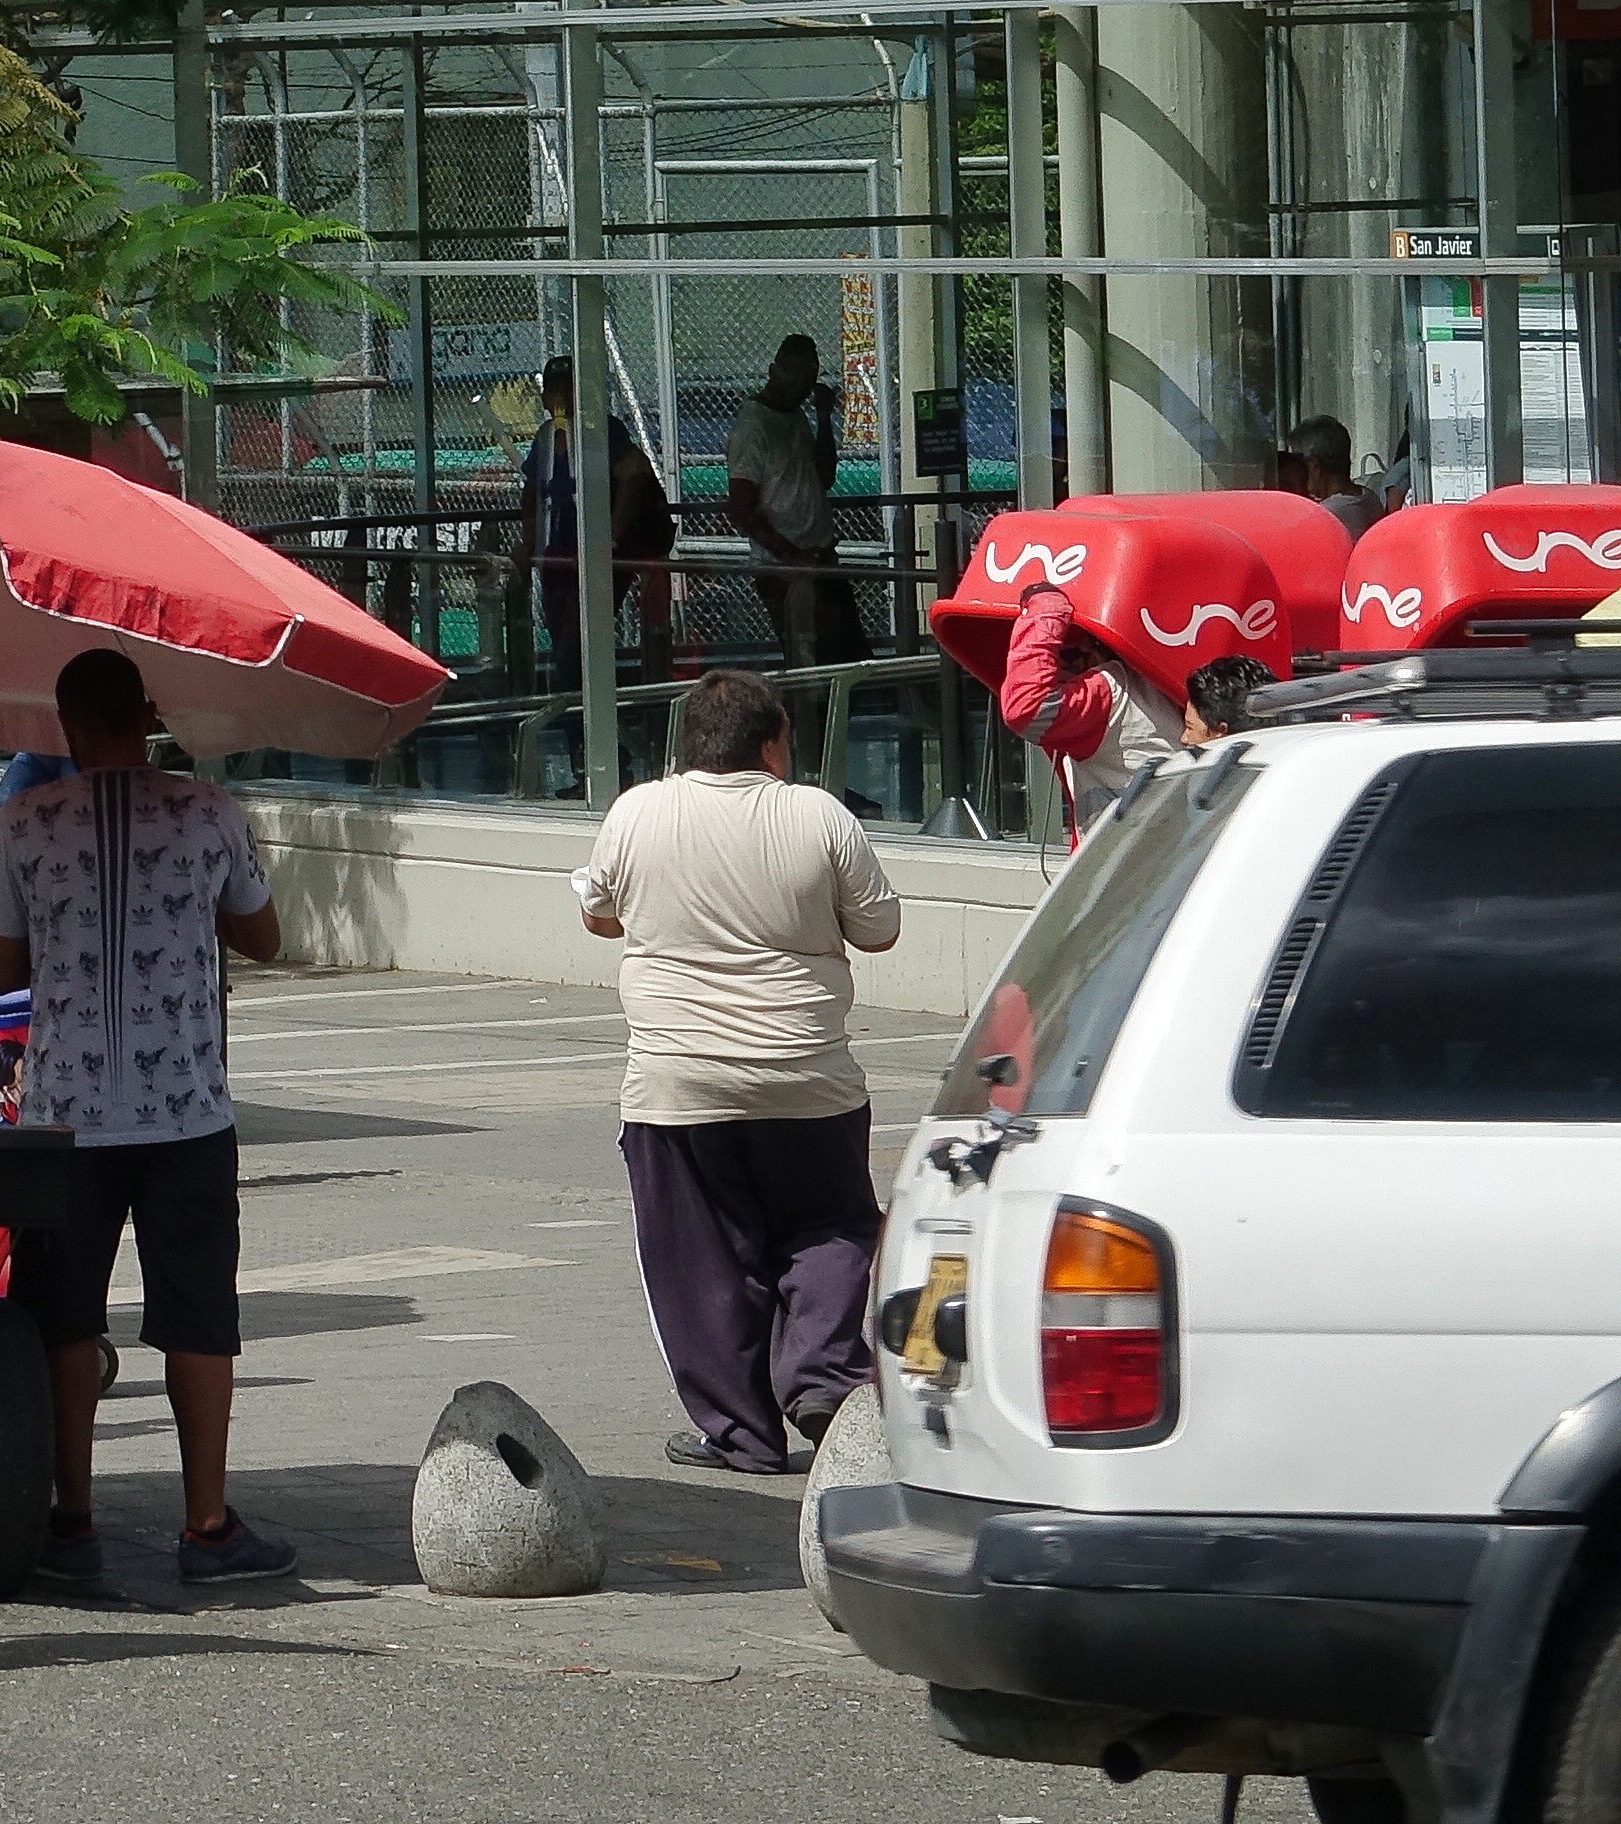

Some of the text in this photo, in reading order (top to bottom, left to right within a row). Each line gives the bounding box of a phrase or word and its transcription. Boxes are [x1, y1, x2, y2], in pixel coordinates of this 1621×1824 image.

[1395, 234, 1473, 257] B San Javier
[985, 539, 1087, 585] une
[1483, 530, 1621, 573] une
[1141, 599, 1278, 647] une
[1343, 580, 1423, 629] une
